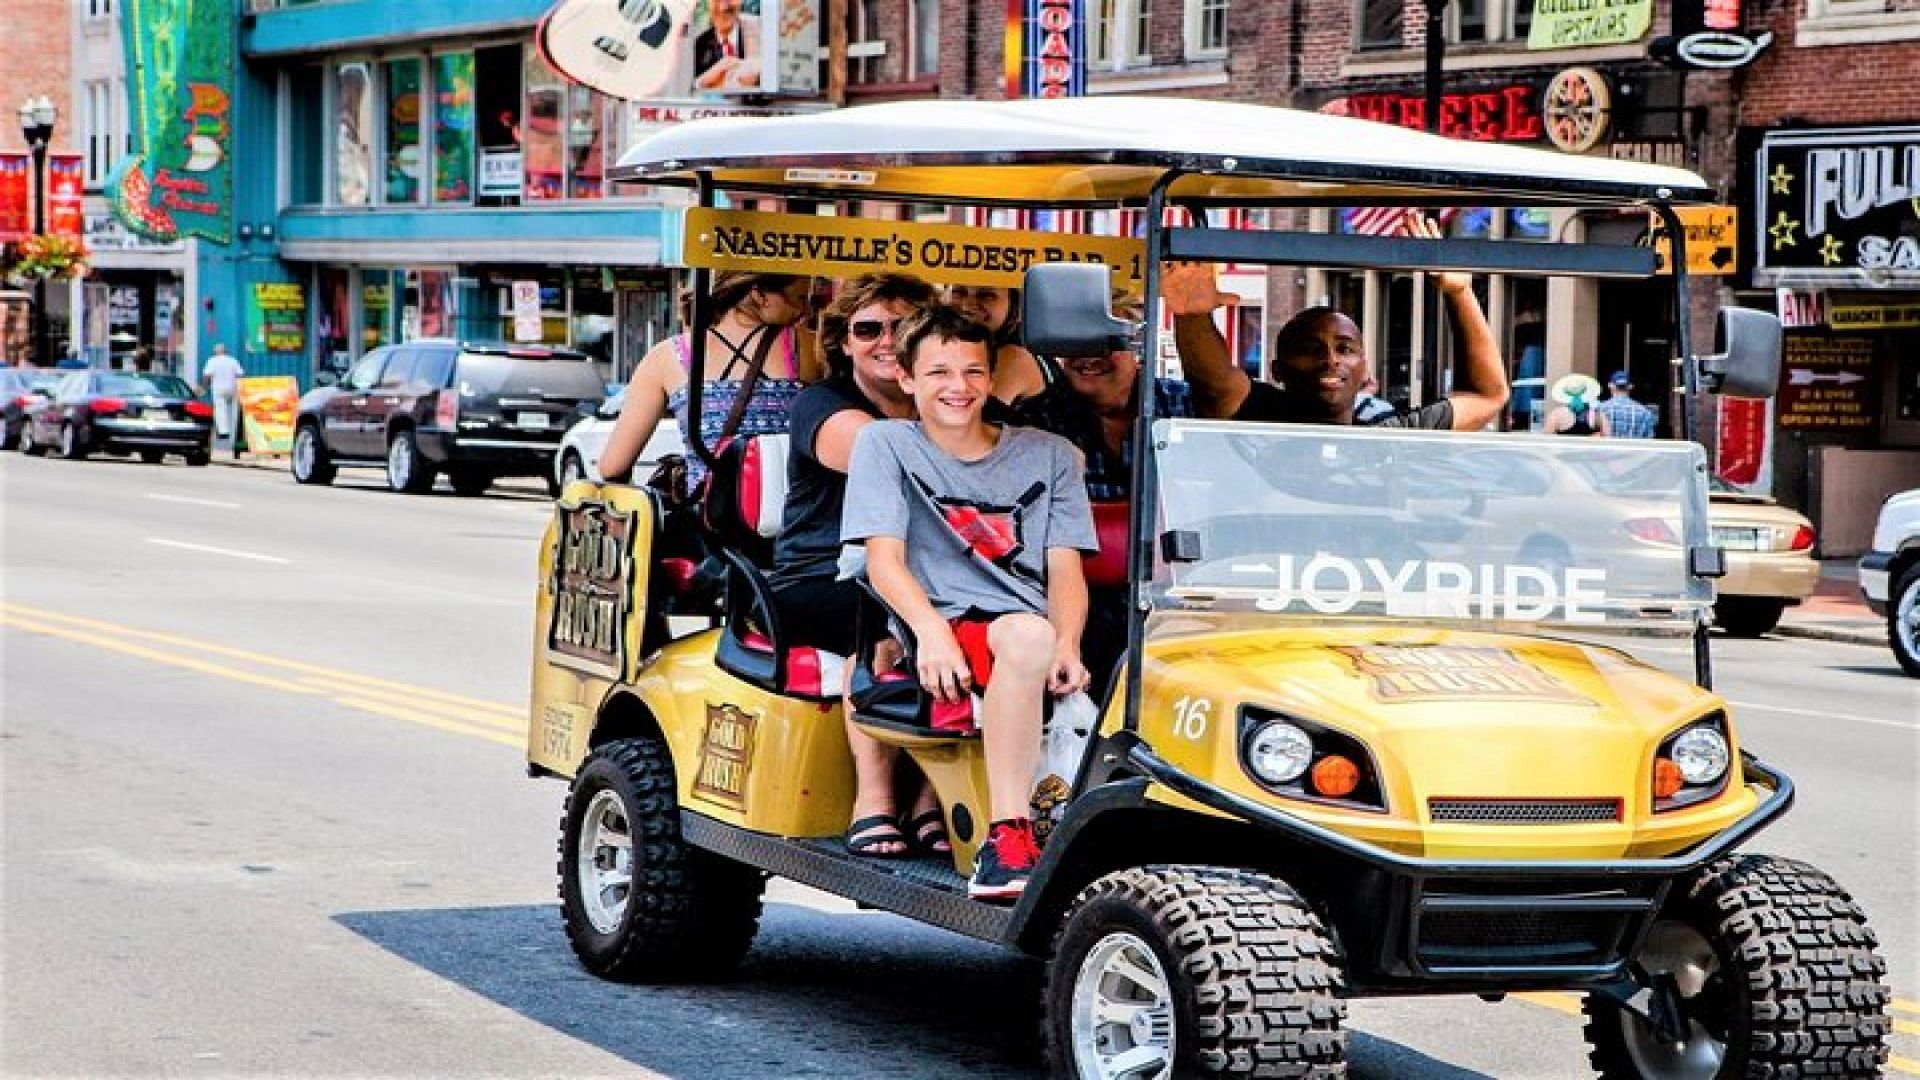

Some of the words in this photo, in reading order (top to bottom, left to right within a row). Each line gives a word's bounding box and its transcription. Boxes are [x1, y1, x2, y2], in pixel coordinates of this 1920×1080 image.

[640, 107, 681, 121] REAL
[1349, 85, 1544, 140] WHEEL
[713, 226, 912, 266] NASHVILLE'S
[920, 238, 1036, 272] OLDEST
[563, 529, 620, 581] GOLD
[1254, 551, 1608, 622] JOYRIDE
[553, 591, 618, 653] RUSH
[708, 716, 746, 750] GOLD
[1172, 695, 1212, 739] 16
[698, 755, 744, 793] RUSH
